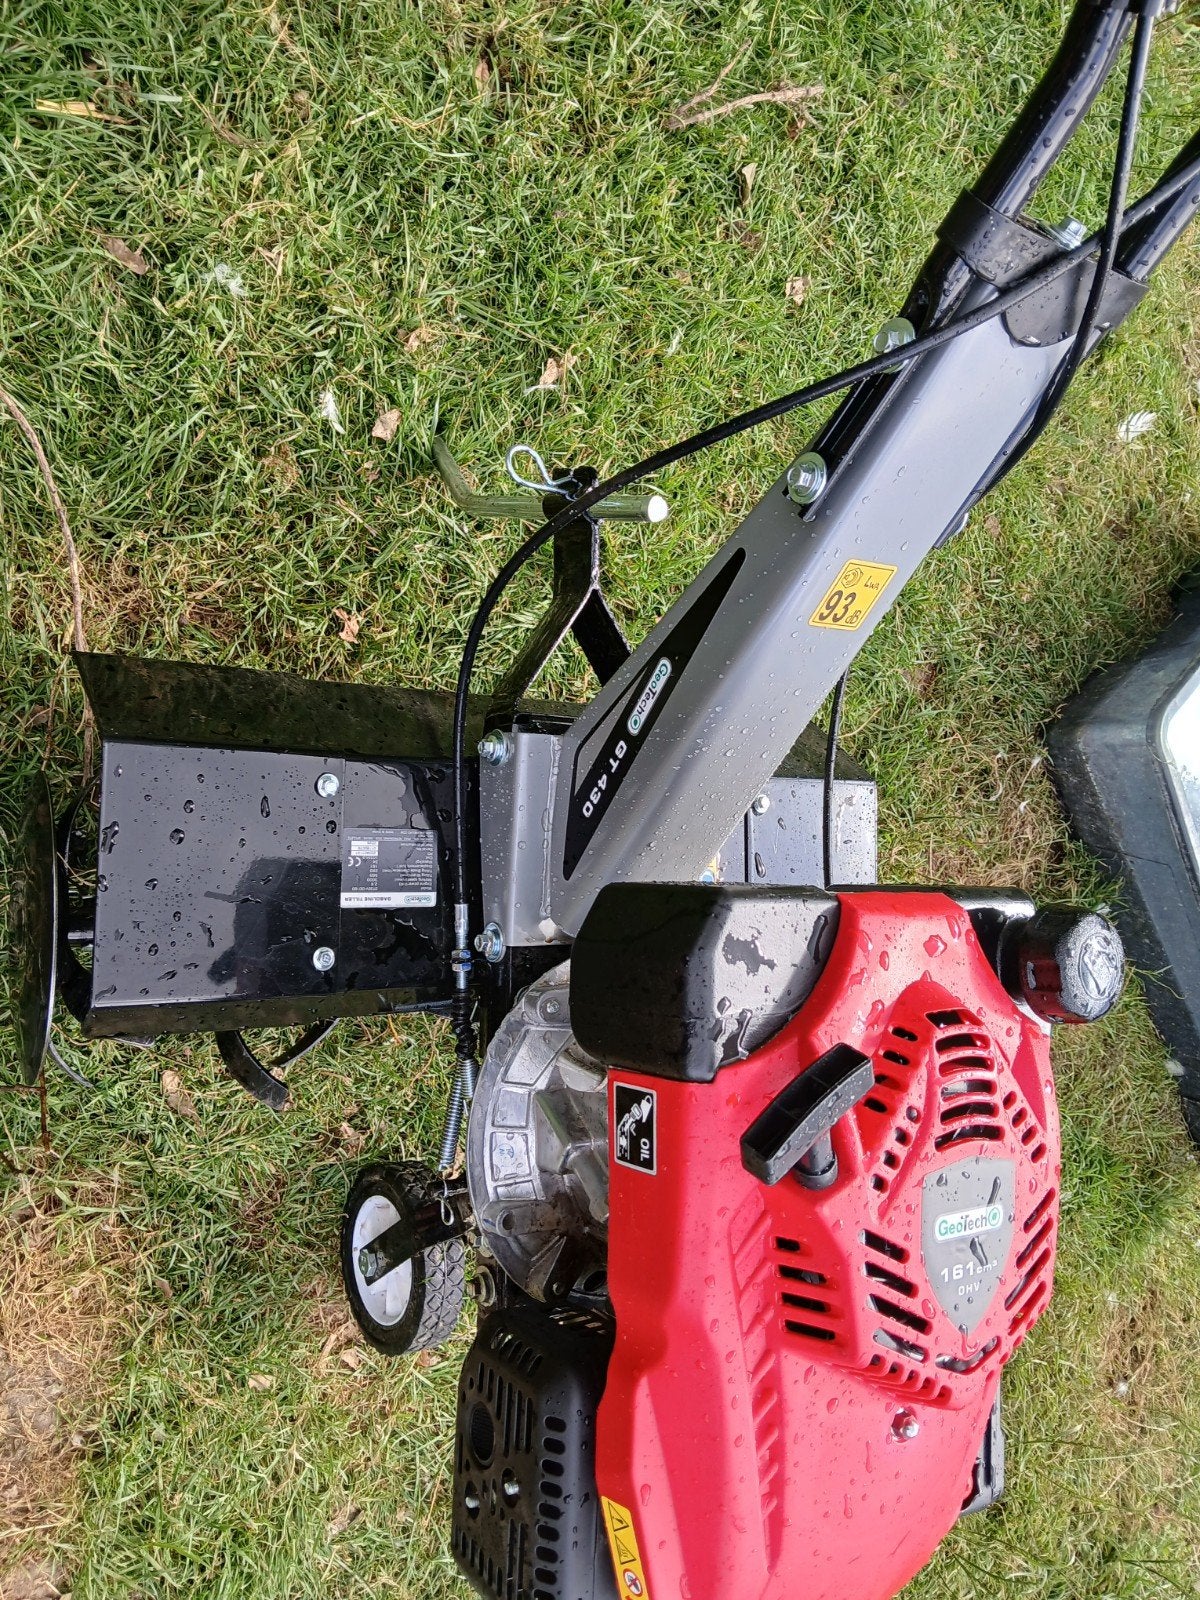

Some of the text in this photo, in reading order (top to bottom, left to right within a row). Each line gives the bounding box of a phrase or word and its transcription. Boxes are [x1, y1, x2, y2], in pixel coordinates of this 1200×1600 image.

[818, 590, 862, 624] 93 dB
[637, 662, 669, 716] GeoTech
[582, 740, 628, 818] GT 430
[640, 1137, 650, 1161] OIL
[938, 1213, 988, 1237] GeoTech
[958, 1281, 980, 1296] OHV
